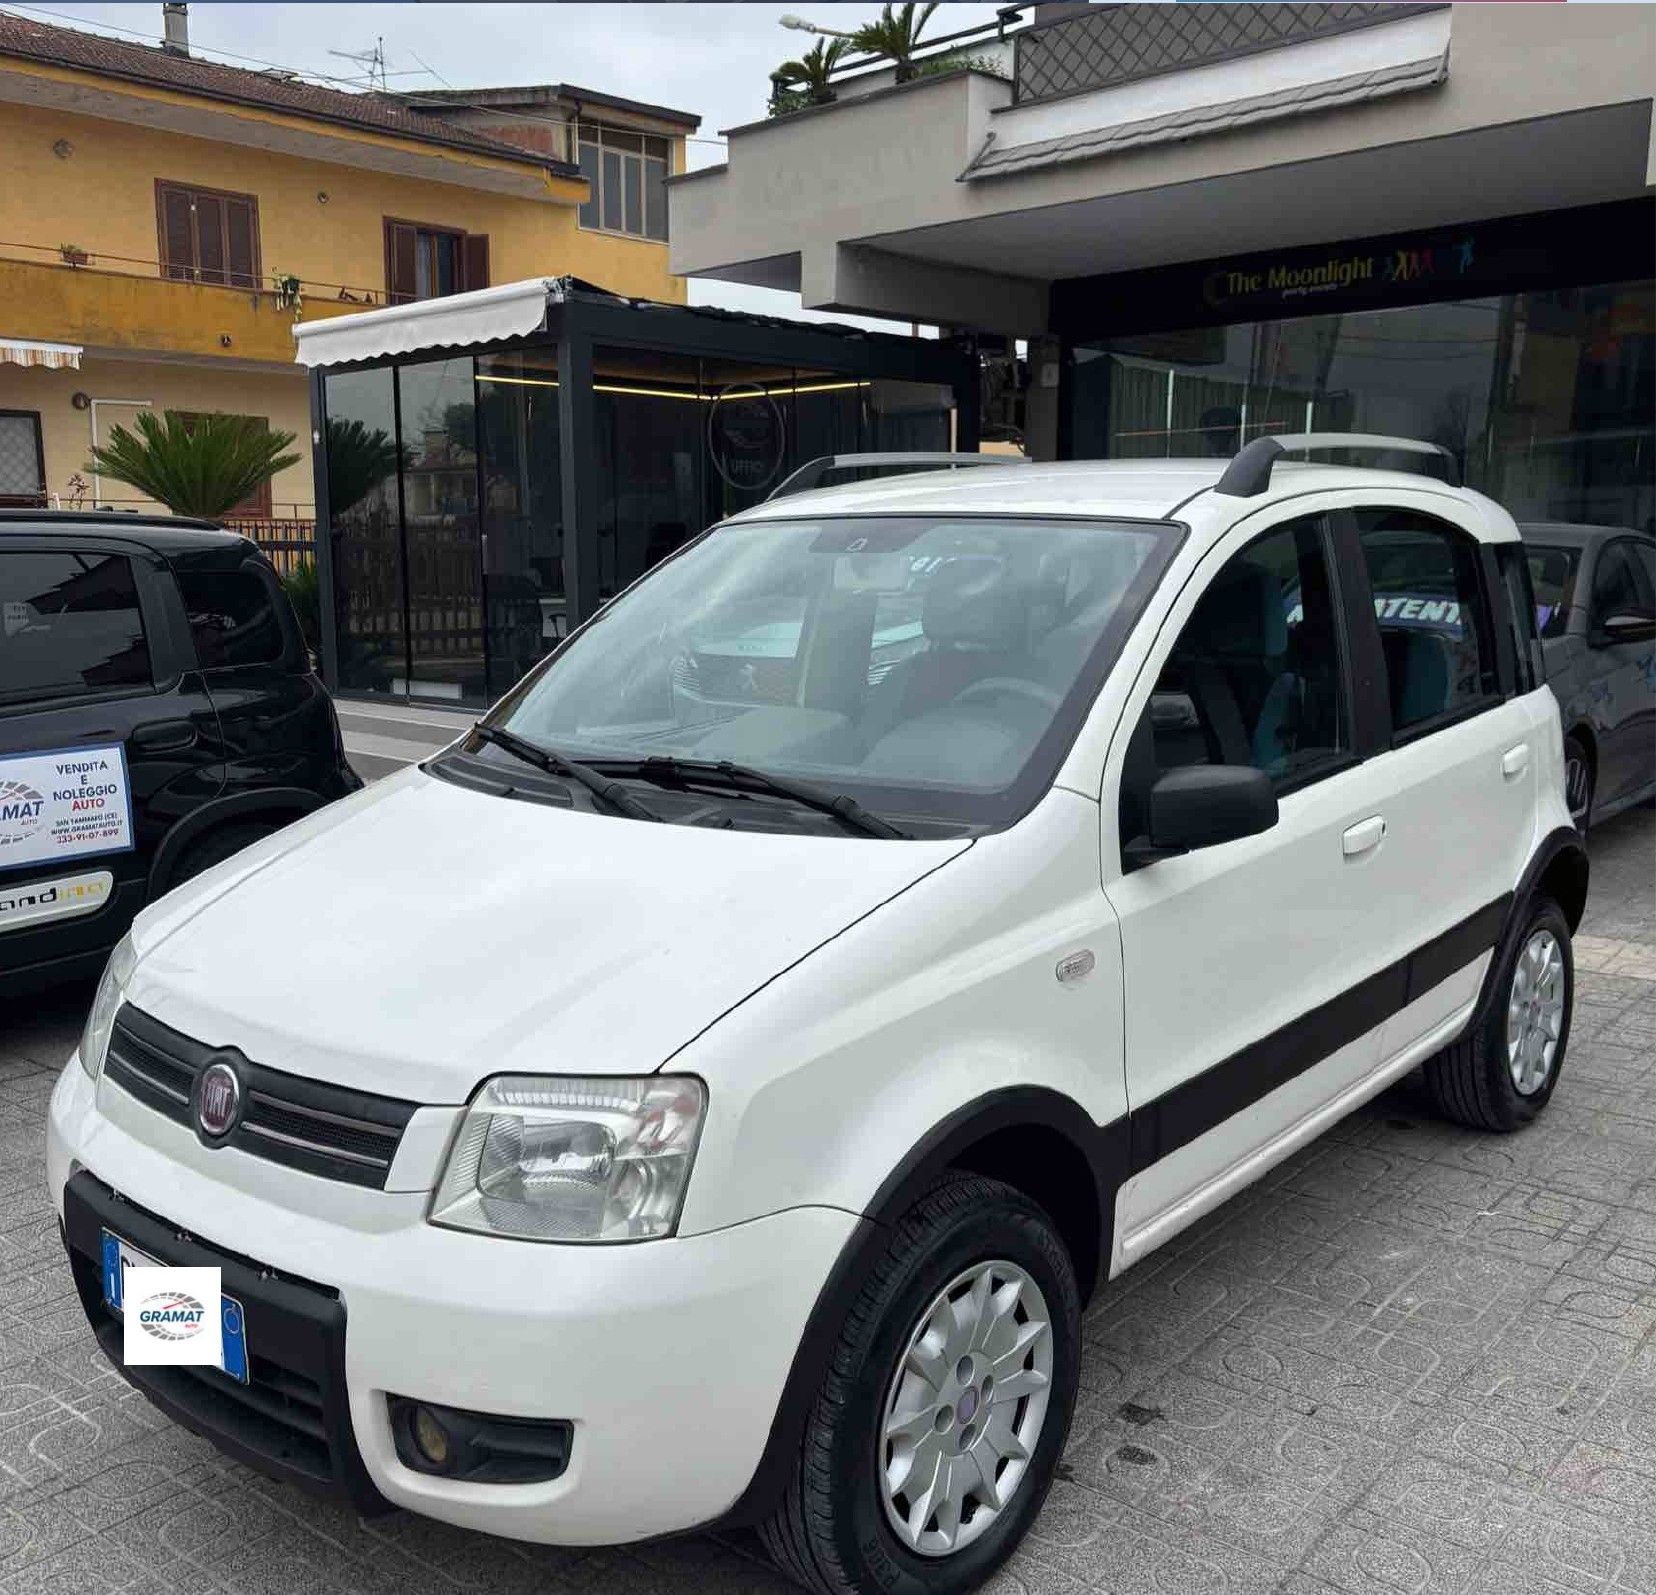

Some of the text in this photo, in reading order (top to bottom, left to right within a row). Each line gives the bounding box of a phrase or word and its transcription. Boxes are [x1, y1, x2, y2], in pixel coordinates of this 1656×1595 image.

[1227, 256, 1374, 295] The Moonlight
[56, 760, 108, 775] VENDITA
[80, 774, 88, 785] E
[53, 784, 118, 801] NOLEGGIO
[71, 798, 105, 811] AUTO
